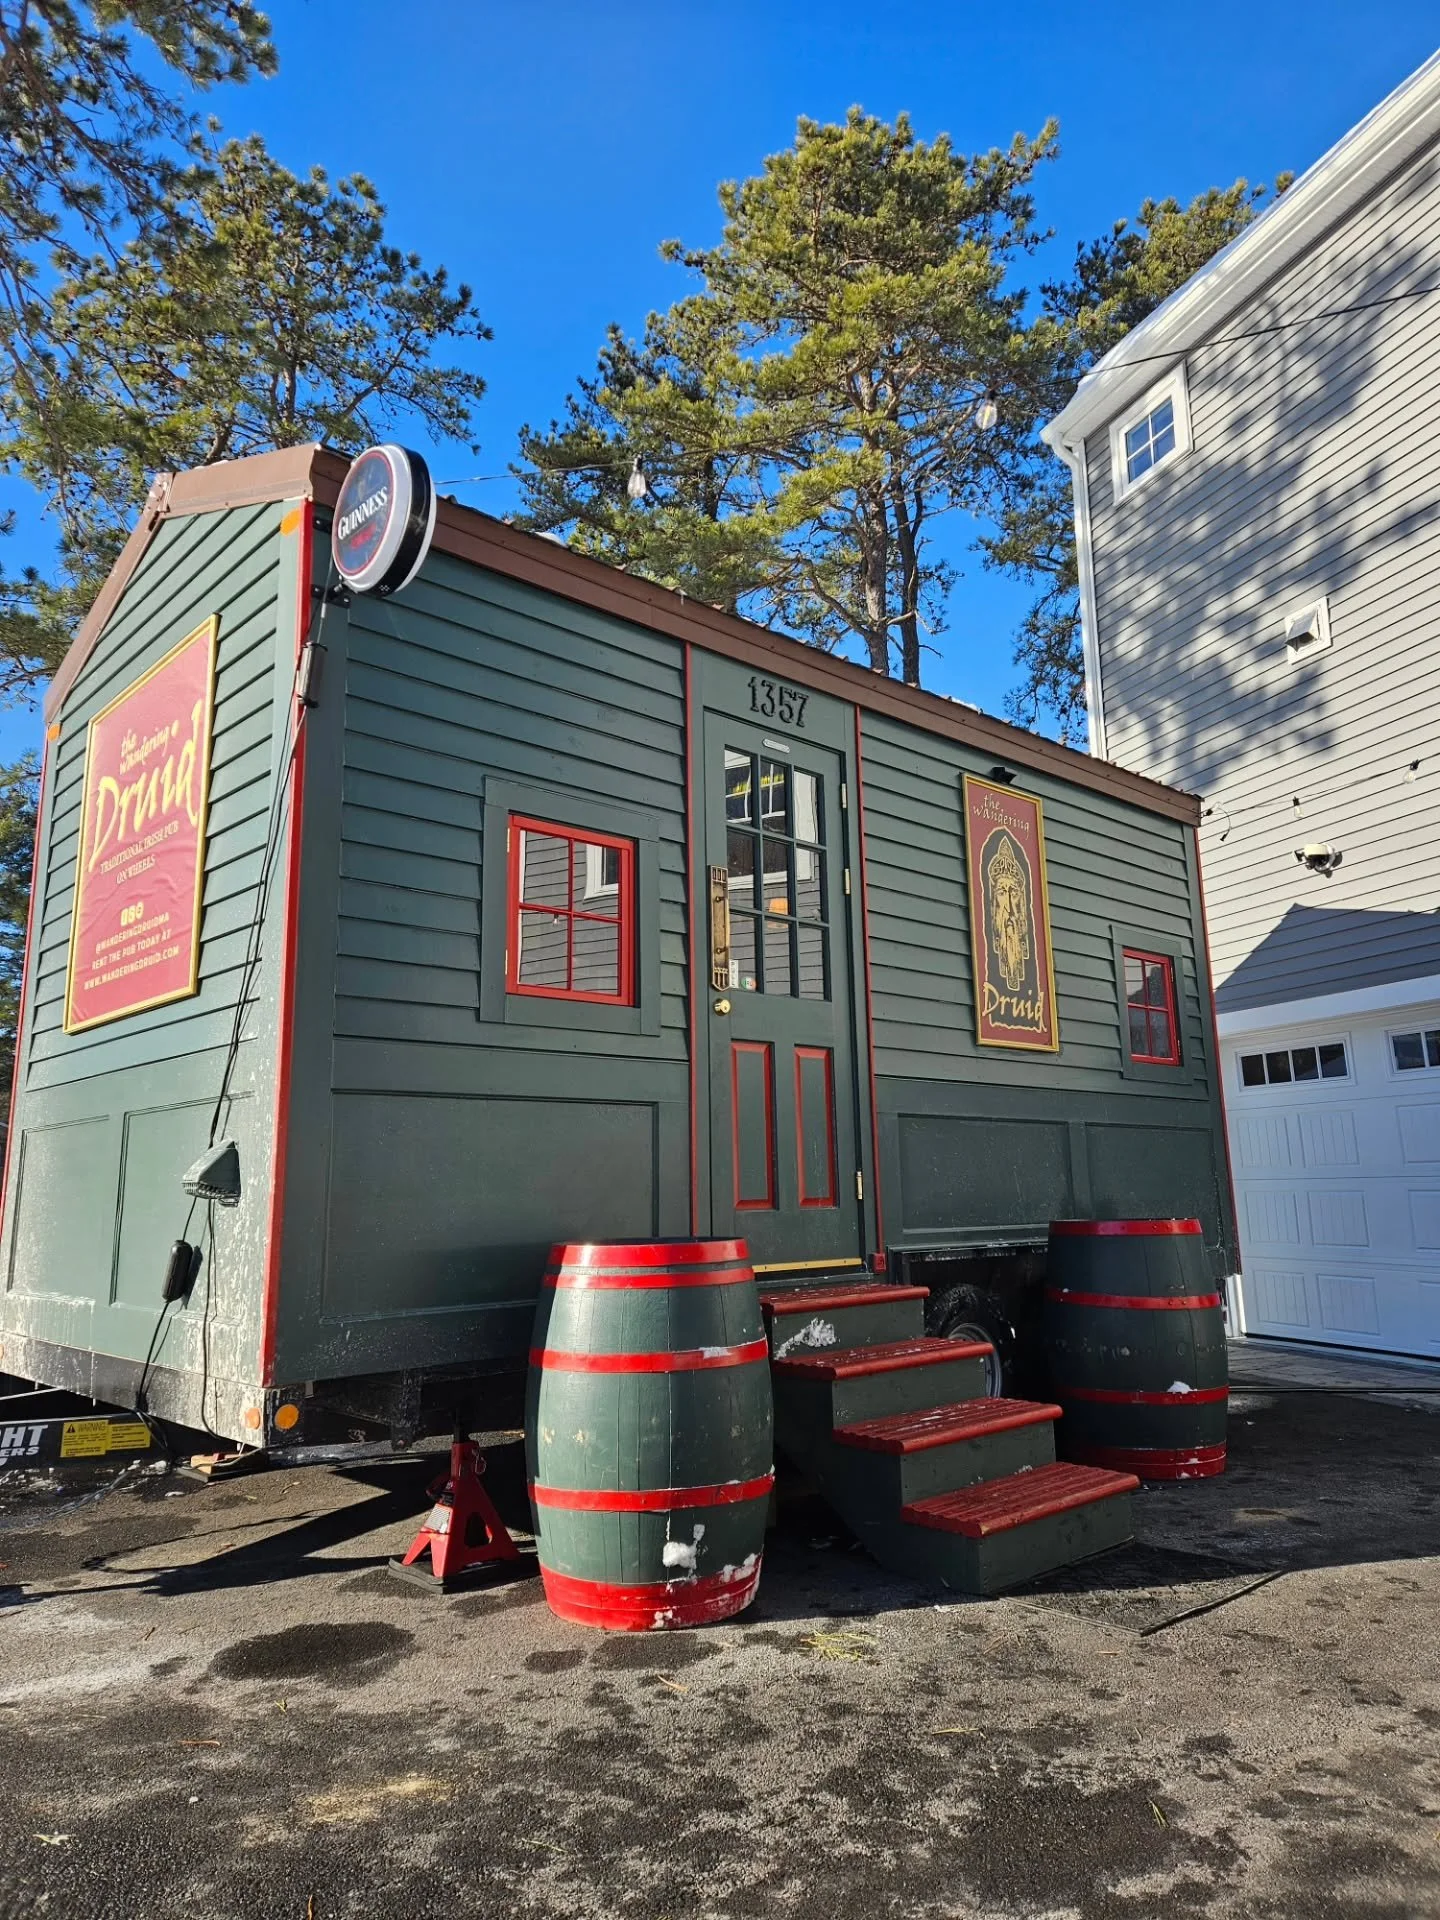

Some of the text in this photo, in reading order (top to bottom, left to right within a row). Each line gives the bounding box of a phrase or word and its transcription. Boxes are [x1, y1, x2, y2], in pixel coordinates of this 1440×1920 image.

[337, 486, 388, 540] GUINNESS
[748, 676, 809, 728] 1357
[121, 728, 137, 758] the
[88, 698, 202, 872] Druid
[983, 793, 1000, 810] the
[973, 805, 1030, 841] wandering
[100, 820, 179, 874] TRADITIONAL IRISH PUB
[116, 854, 156, 885] ON WHEELS
[83, 945, 180, 991] WWW.WANDERINGDRUID.COM
[92, 928, 172, 970] RENT THE PUB TODAY AT
[982, 981, 1047, 1033] Druid
[0, 1424, 49, 1448] HT
[78, 1421, 106, 1432] WARNING
